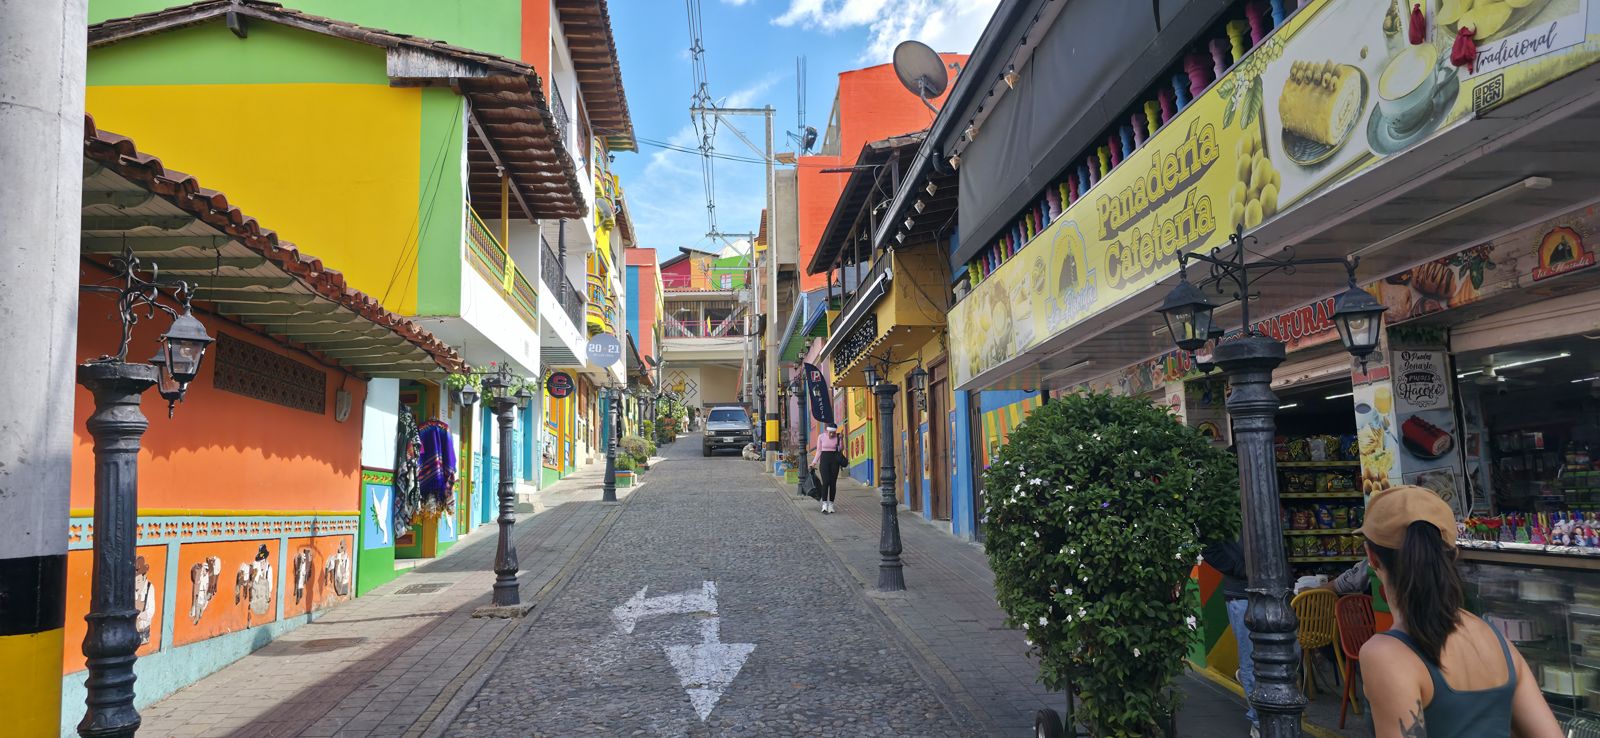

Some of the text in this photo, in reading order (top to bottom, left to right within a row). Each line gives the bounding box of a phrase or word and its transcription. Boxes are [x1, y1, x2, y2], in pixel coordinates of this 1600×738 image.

[1475, 21, 1558, 73] Tradicional
[1096, 115, 1219, 241] Panadería
[1104, 186, 1216, 288] Cafetería
[588, 343, 620, 354] 20 21
